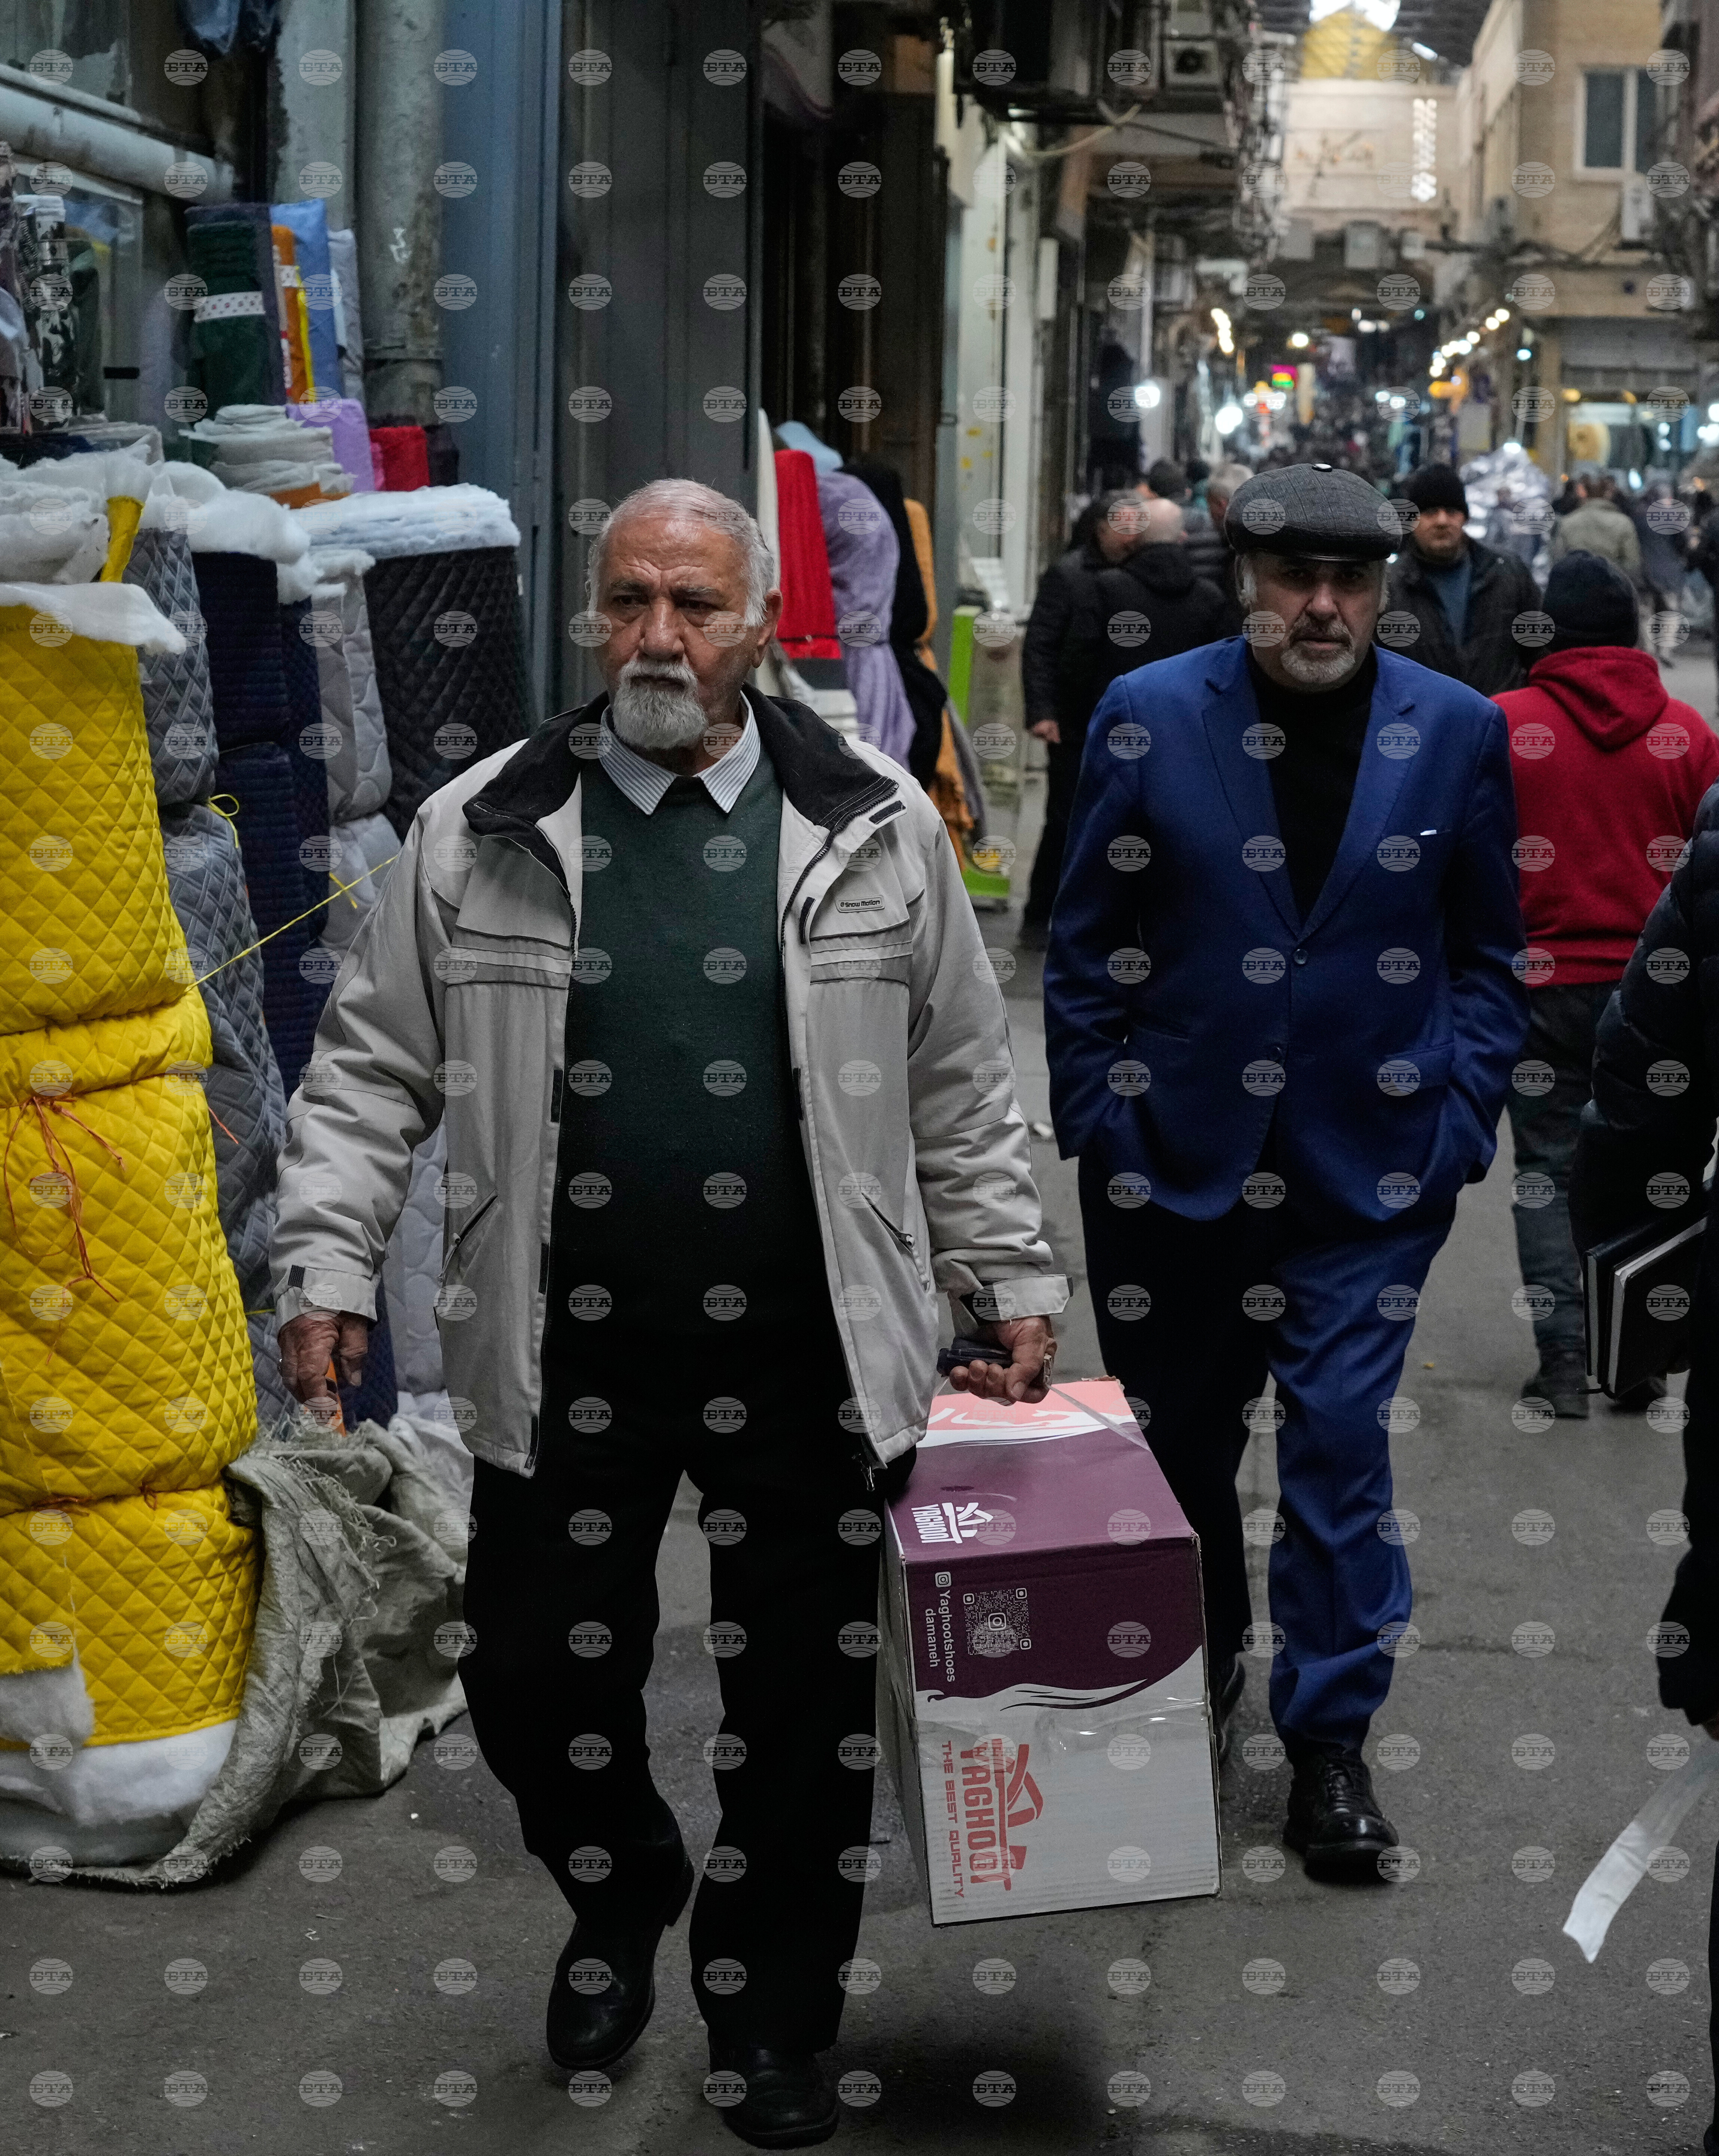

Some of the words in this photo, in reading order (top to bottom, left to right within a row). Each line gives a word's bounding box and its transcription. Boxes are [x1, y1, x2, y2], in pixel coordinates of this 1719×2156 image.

[925, 1608, 940, 1667] damaneh
[938, 1589, 955, 1682] Yaghootshoes
[942, 1740, 953, 1774] THE
[945, 1780, 958, 1823] BEST
[949, 1830, 964, 1898] QUALITY
